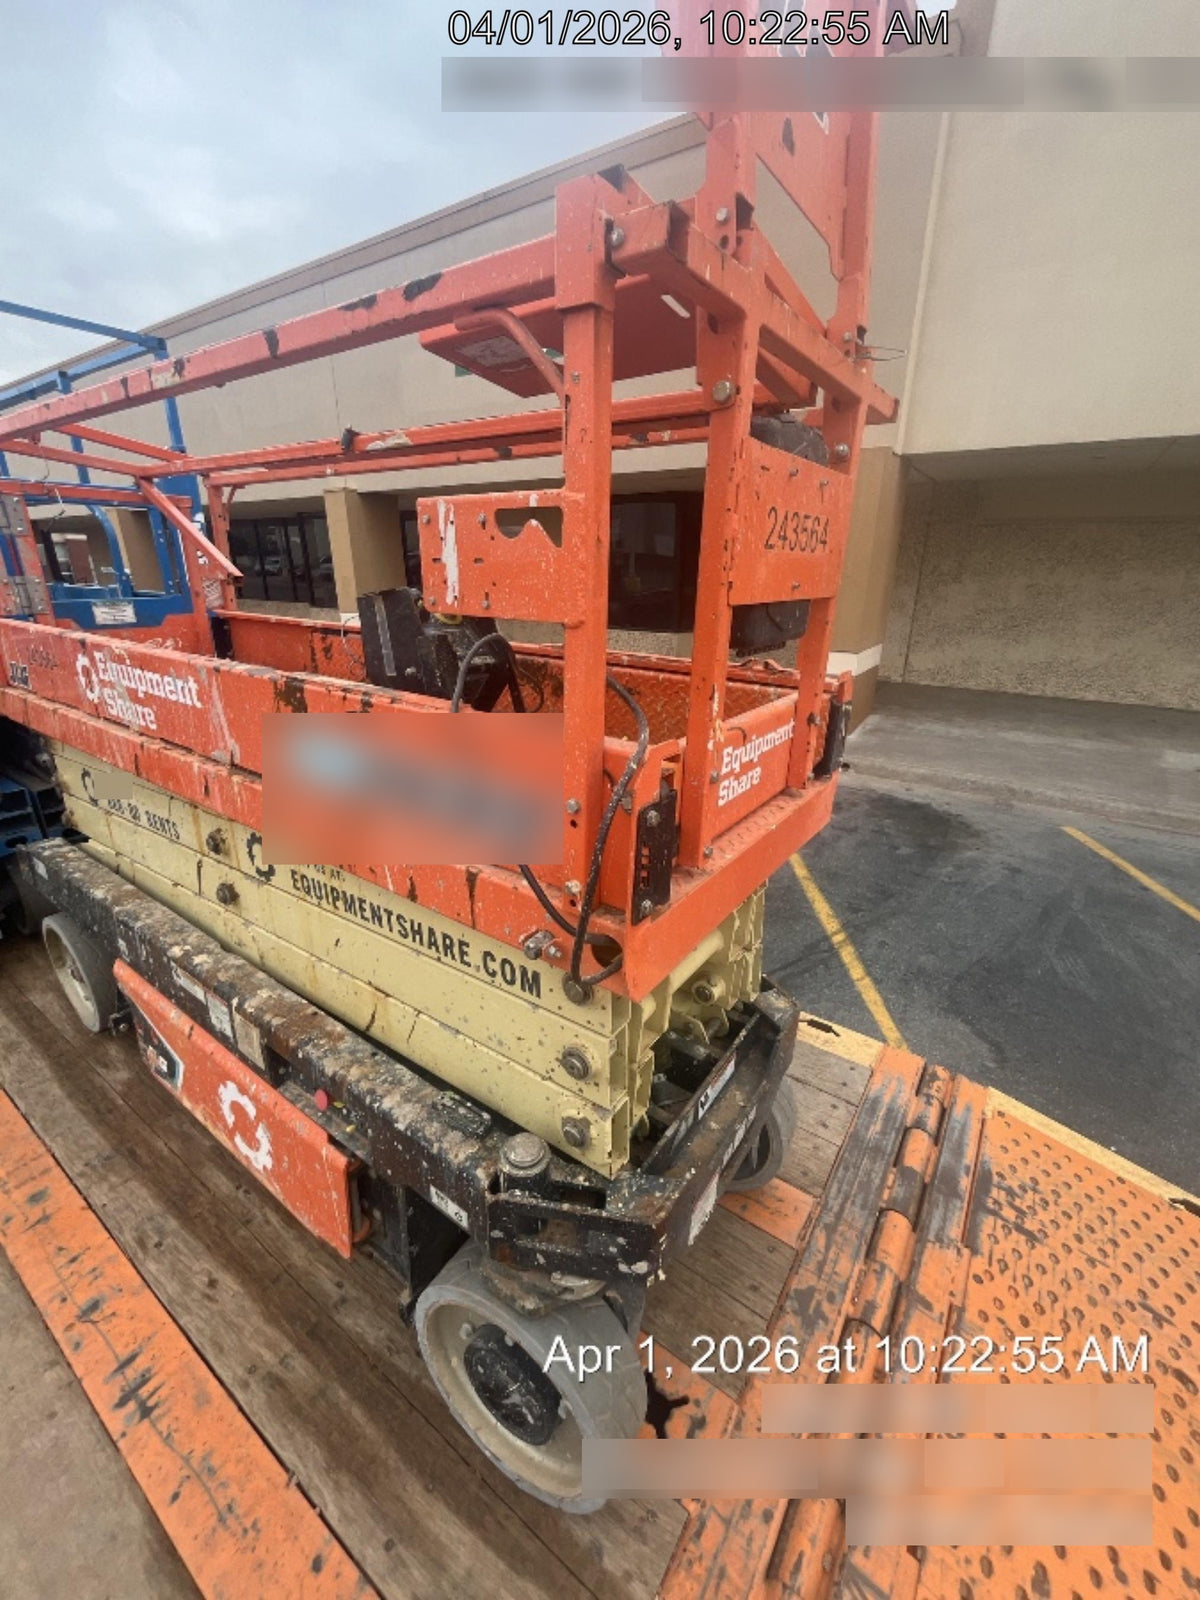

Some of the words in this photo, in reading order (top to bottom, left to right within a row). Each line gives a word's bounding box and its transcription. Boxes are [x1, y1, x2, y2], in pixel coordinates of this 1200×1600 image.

[764, 506, 829, 553] 243564
[93, 650, 202, 709] Equipment
[103, 687, 157, 730] Share
[721, 717, 795, 775] Equipment
[717, 766, 761, 807] Share
[290, 868, 542, 999] EQUIPMENTSHARE.COM
